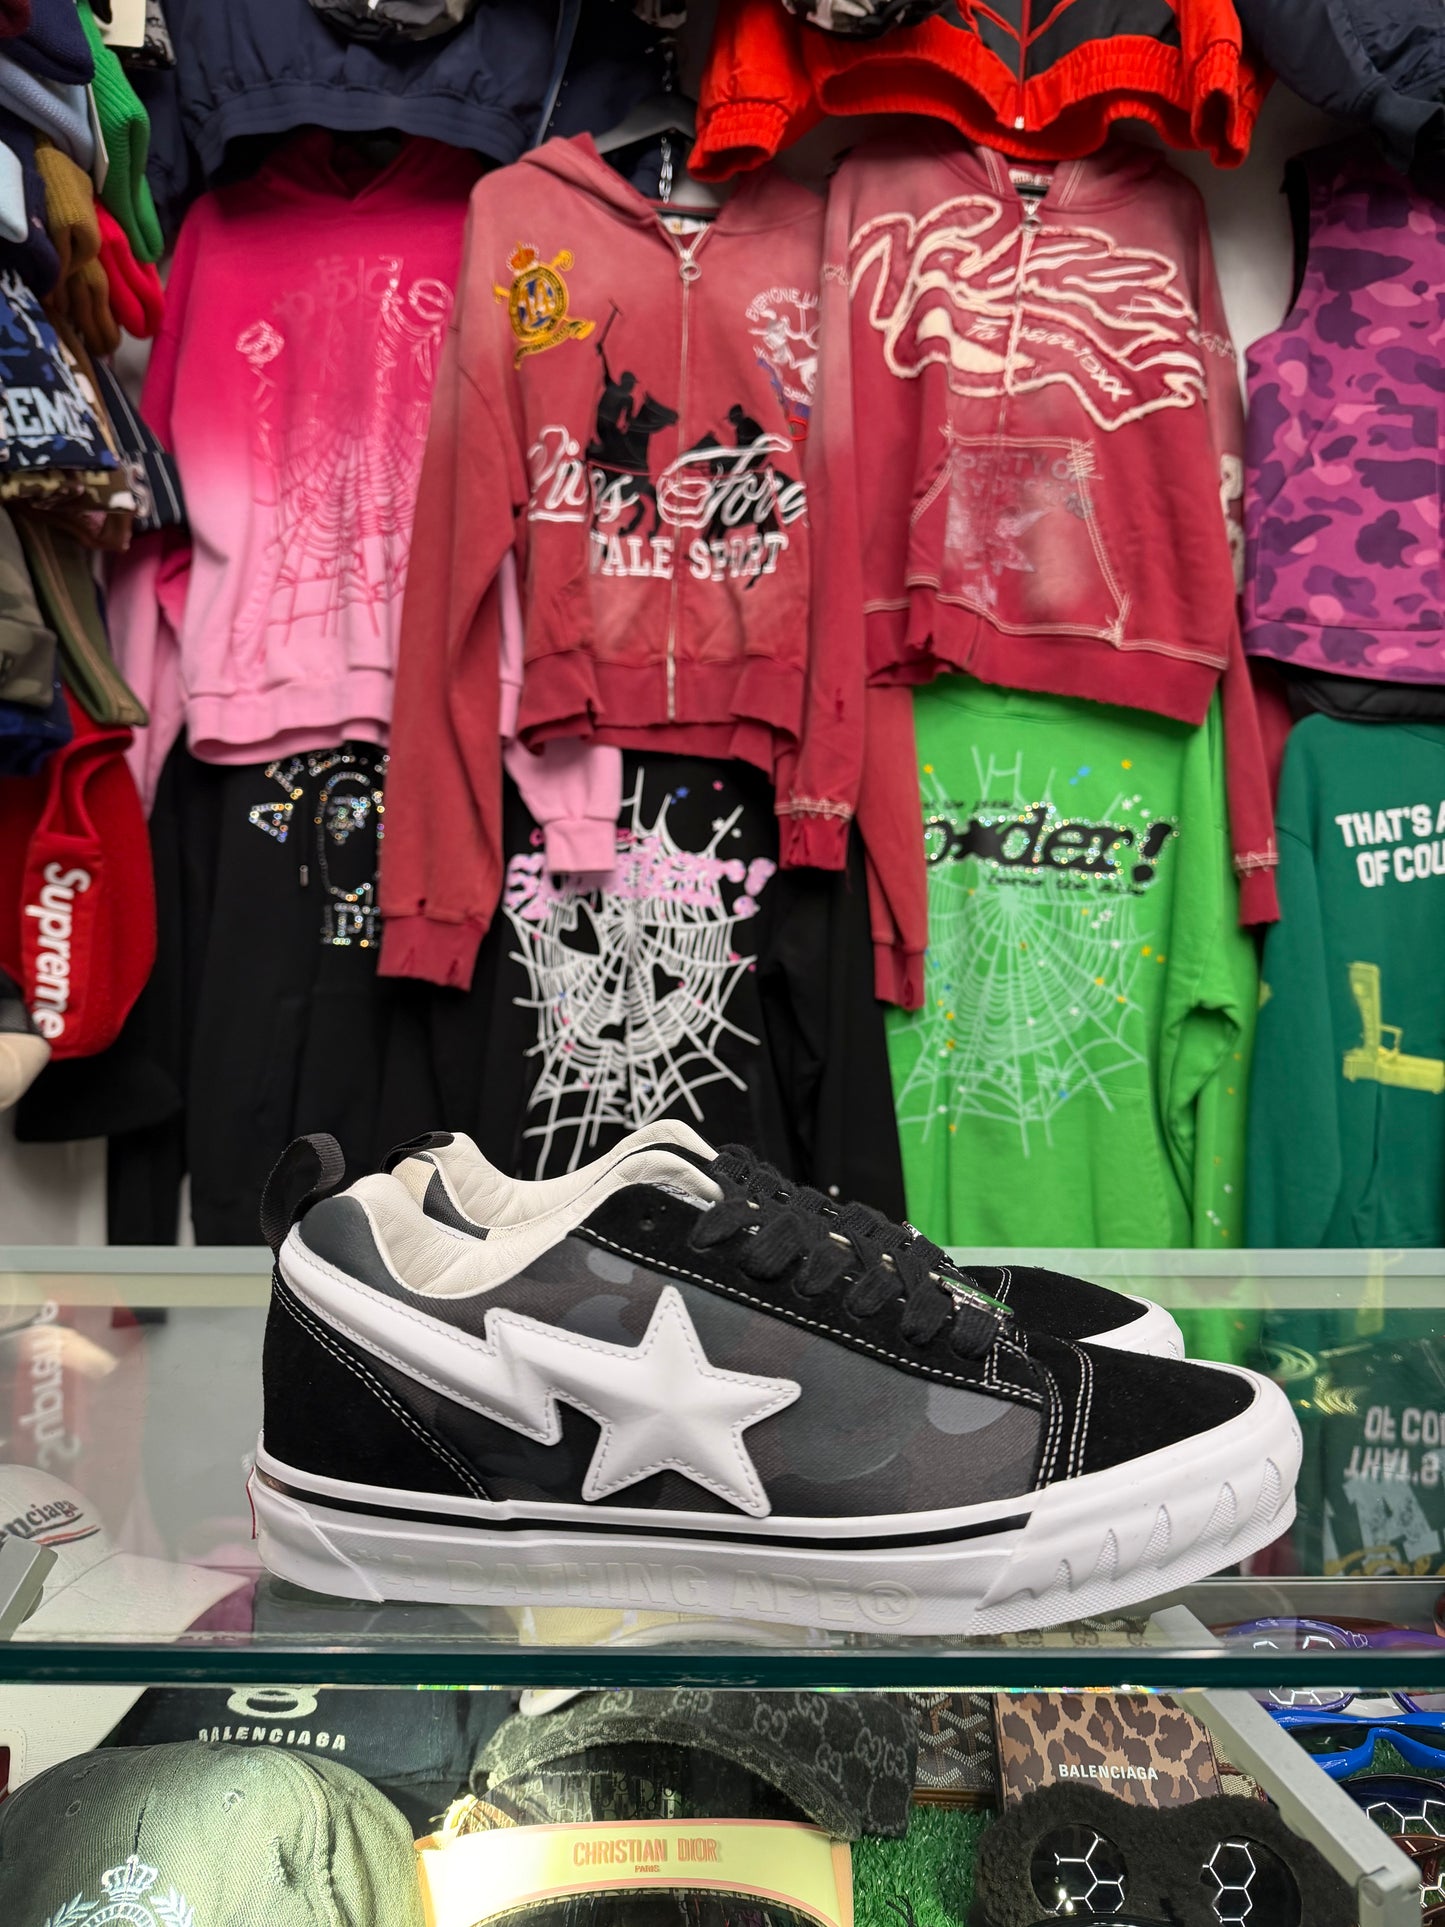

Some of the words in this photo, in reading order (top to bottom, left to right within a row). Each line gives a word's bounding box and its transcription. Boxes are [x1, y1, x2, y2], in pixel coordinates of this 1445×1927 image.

[1334, 803, 1433, 848] THAT'S
[1356, 849, 1391, 888] OF
[25, 862, 91, 1039] Supreme
[446, 1559, 710, 1608] BATHING
[197, 1725, 347, 1752] BALENCIAGA
[1058, 1763, 1159, 1780] BALENCIAGA
[572, 1838, 668, 1867] CHRISTIAN
[677, 1837, 718, 1863] DIOR
[634, 1864, 660, 1873] PARIS
